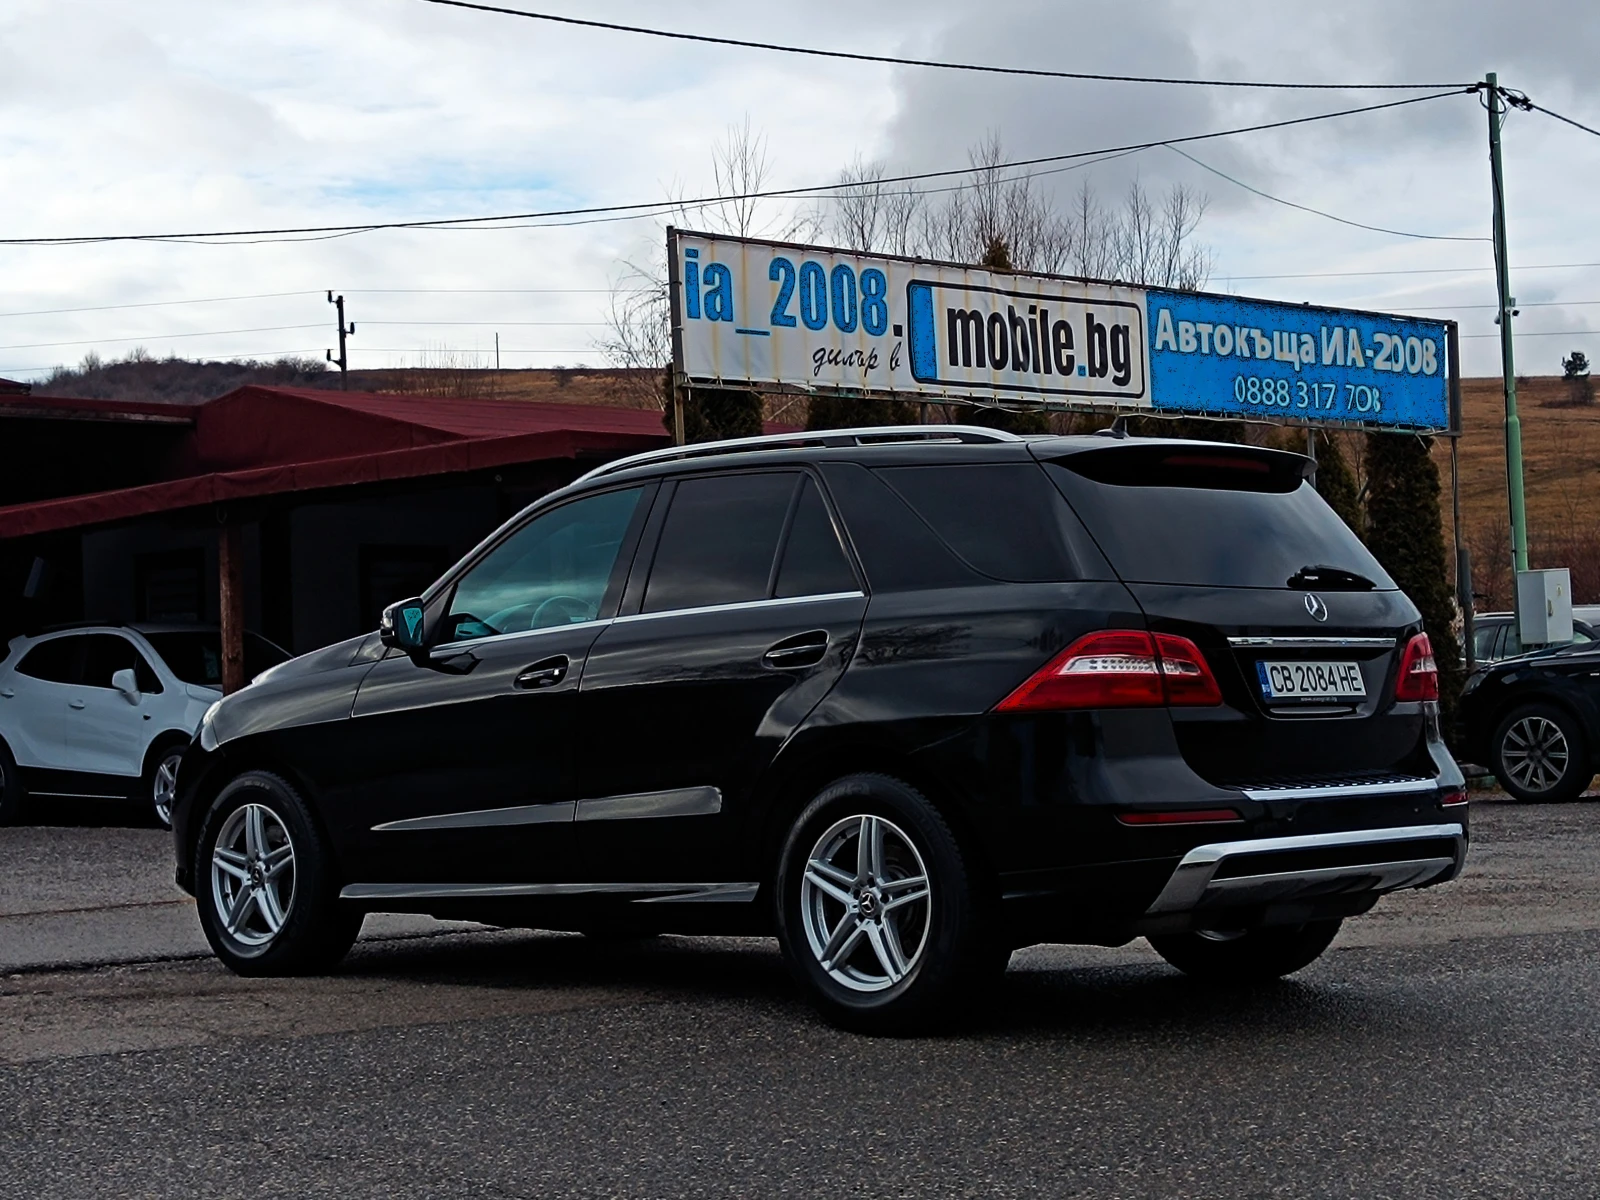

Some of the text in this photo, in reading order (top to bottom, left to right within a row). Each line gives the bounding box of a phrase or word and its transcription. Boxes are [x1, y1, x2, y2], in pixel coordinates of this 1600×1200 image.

[812, 341, 903, 377] дилър в
[946, 304, 1132, 387] mobile.bg
[1154, 308, 1438, 376] Автокъща ИА-2008
[1234, 375, 1381, 412] 0888 317 708
[1270, 665, 1362, 693] CB 2084 HE
